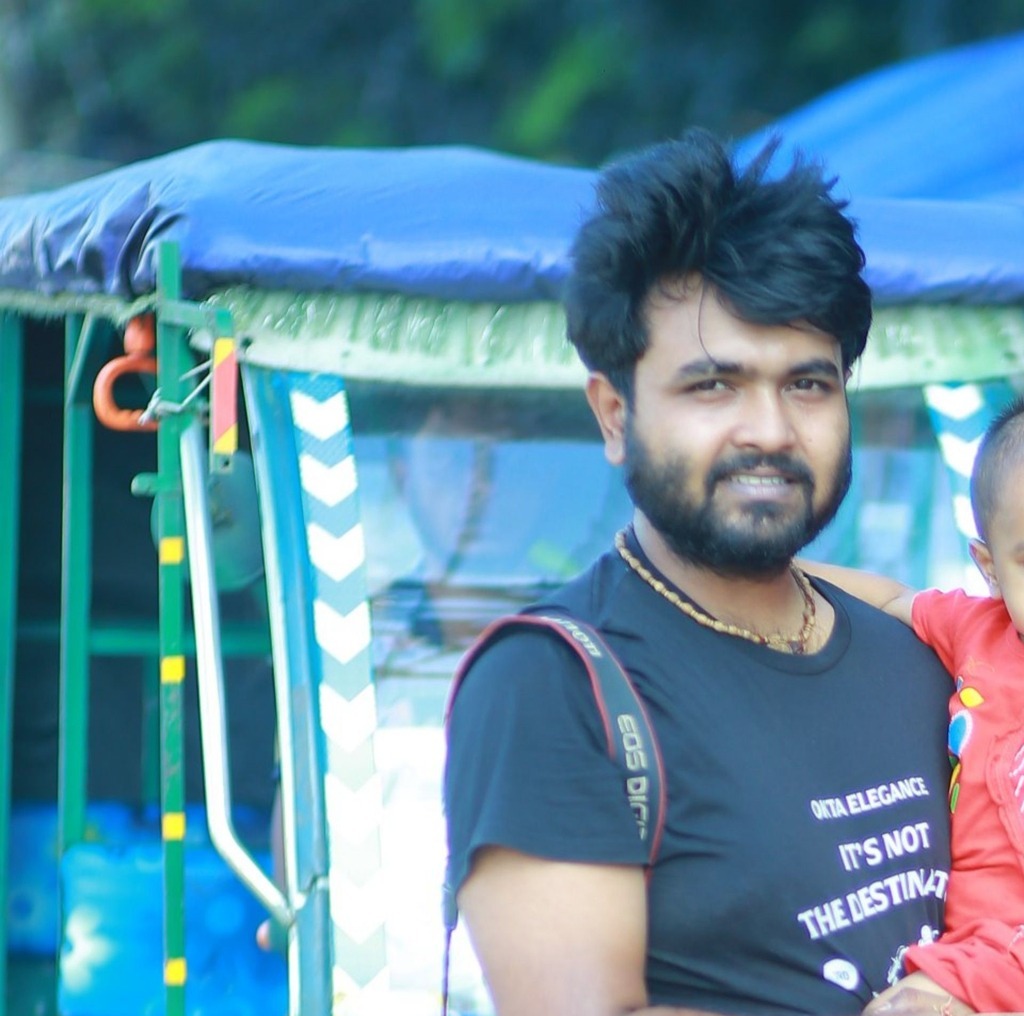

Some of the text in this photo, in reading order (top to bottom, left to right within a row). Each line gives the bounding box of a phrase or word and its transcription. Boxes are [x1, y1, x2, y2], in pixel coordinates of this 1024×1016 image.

[617, 714, 648, 771] EOS
[846, 777, 929, 815] ELEGANCE
[839, 822, 930, 871] IT'S NOT
[798, 868, 949, 940] THE DESTINAT
